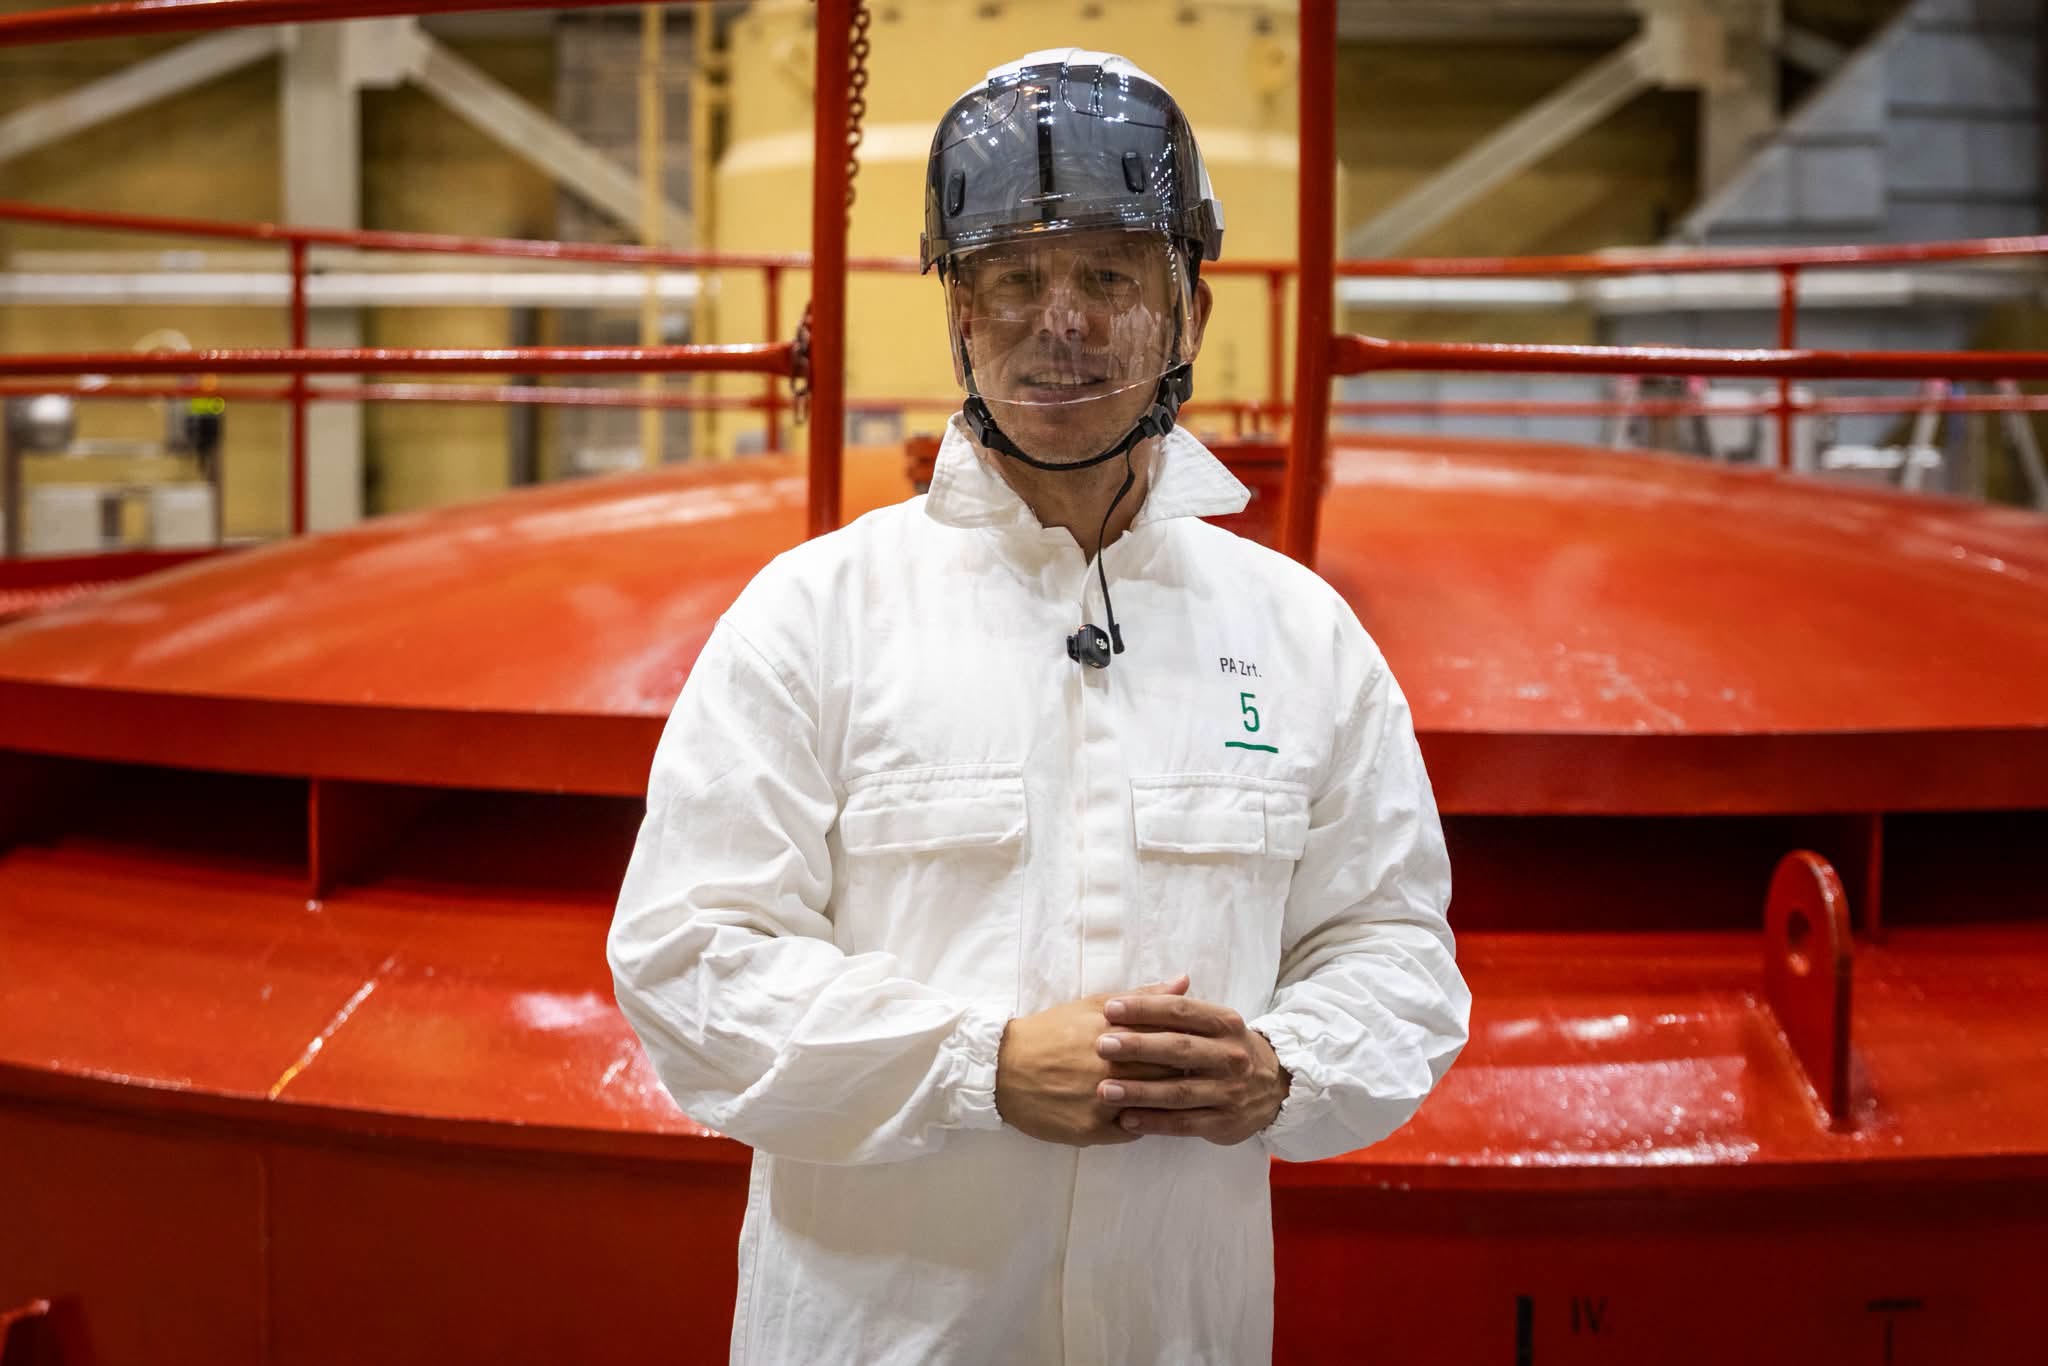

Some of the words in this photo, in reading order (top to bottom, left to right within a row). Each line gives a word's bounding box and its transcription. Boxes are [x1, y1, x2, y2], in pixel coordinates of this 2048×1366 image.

[1219, 657, 1238, 674] PA
[1238, 660, 1262, 678] Zrt.
[1240, 692, 1260, 732] 5
